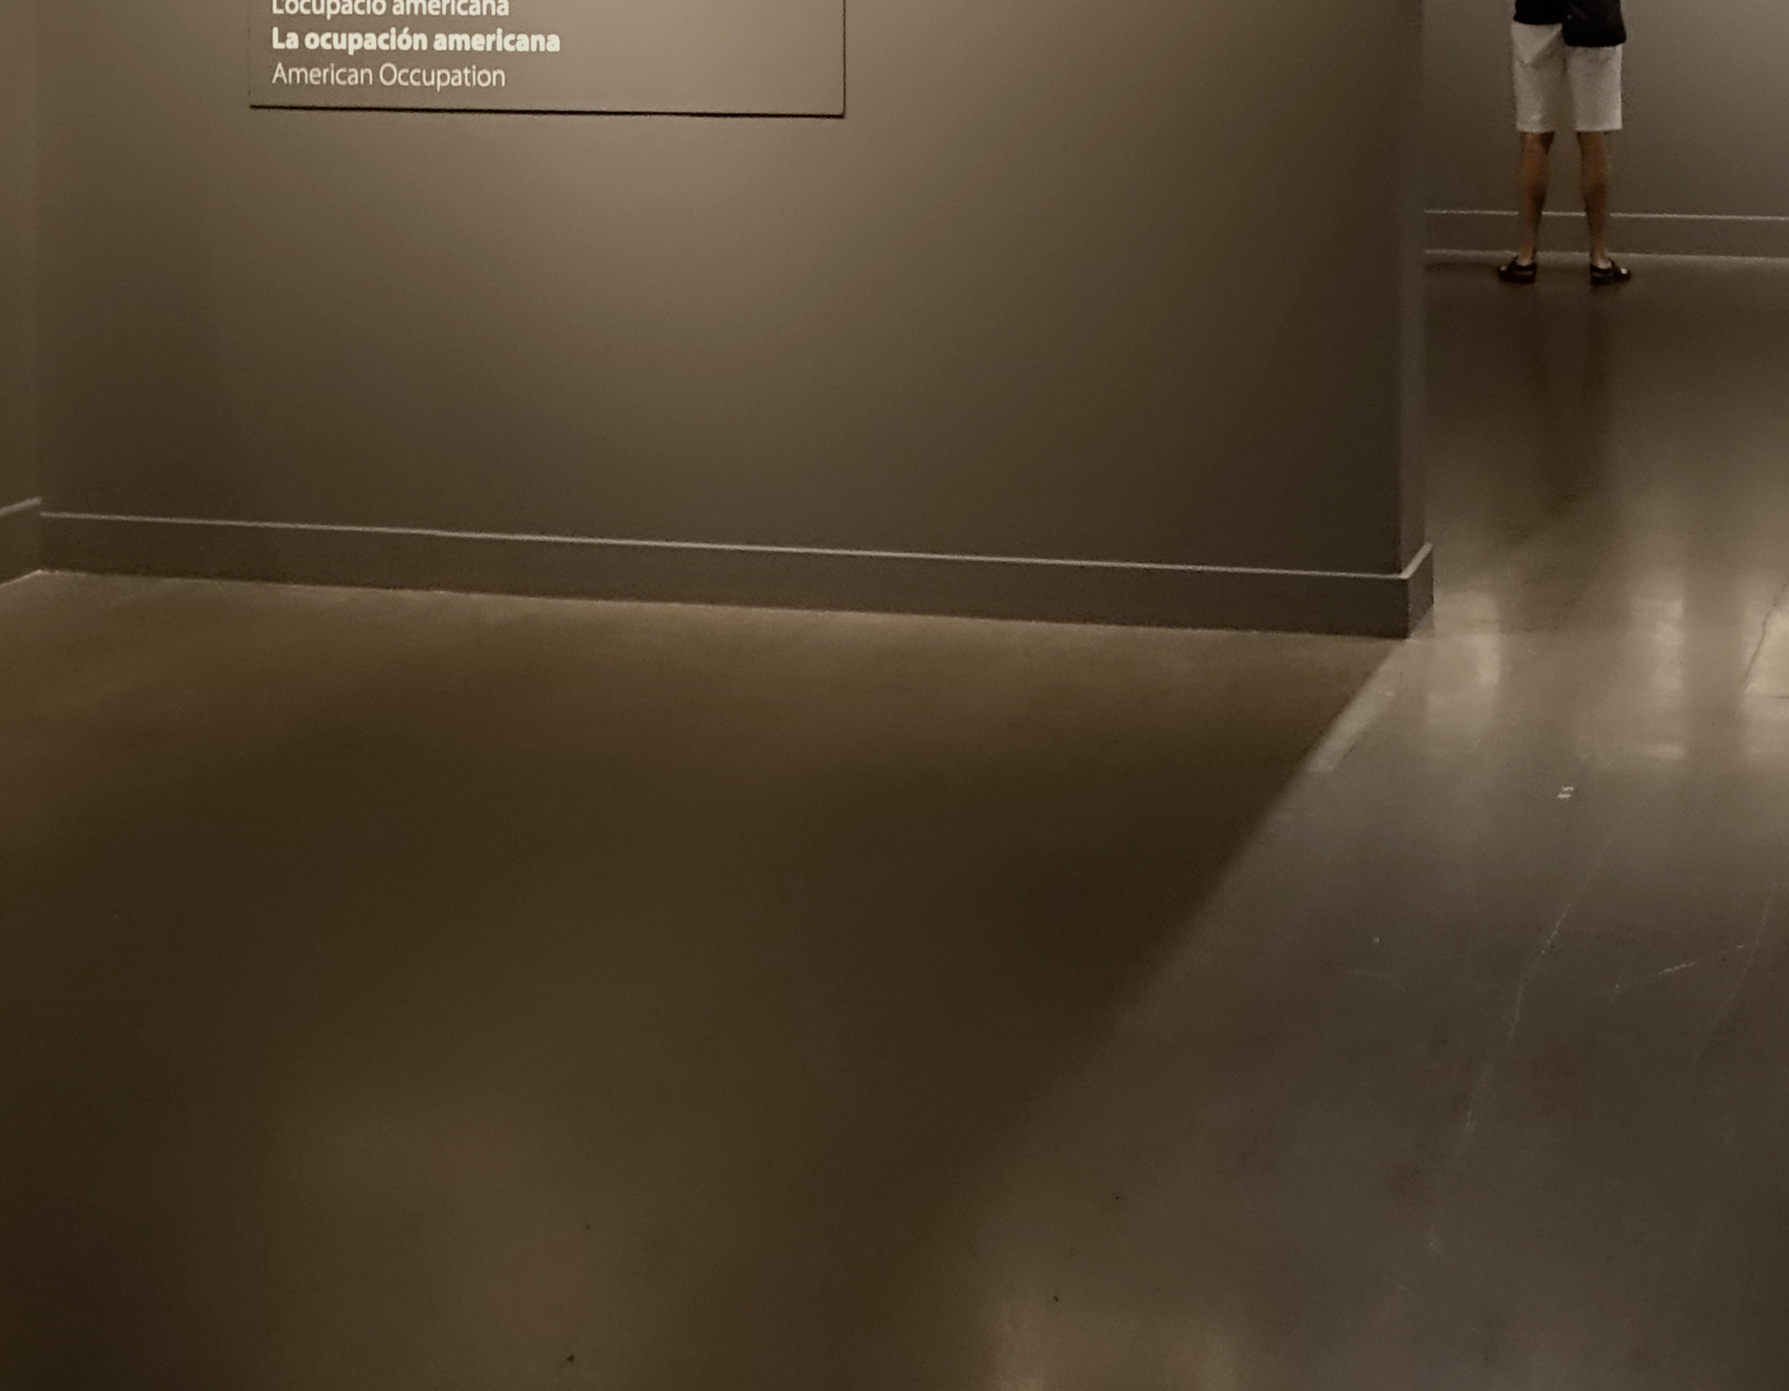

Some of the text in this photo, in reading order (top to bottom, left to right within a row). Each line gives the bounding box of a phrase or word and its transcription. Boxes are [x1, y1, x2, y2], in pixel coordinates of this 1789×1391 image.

[272, 26, 561, 56] La ocupación americana
[272, 62, 506, 92] American Occupation
